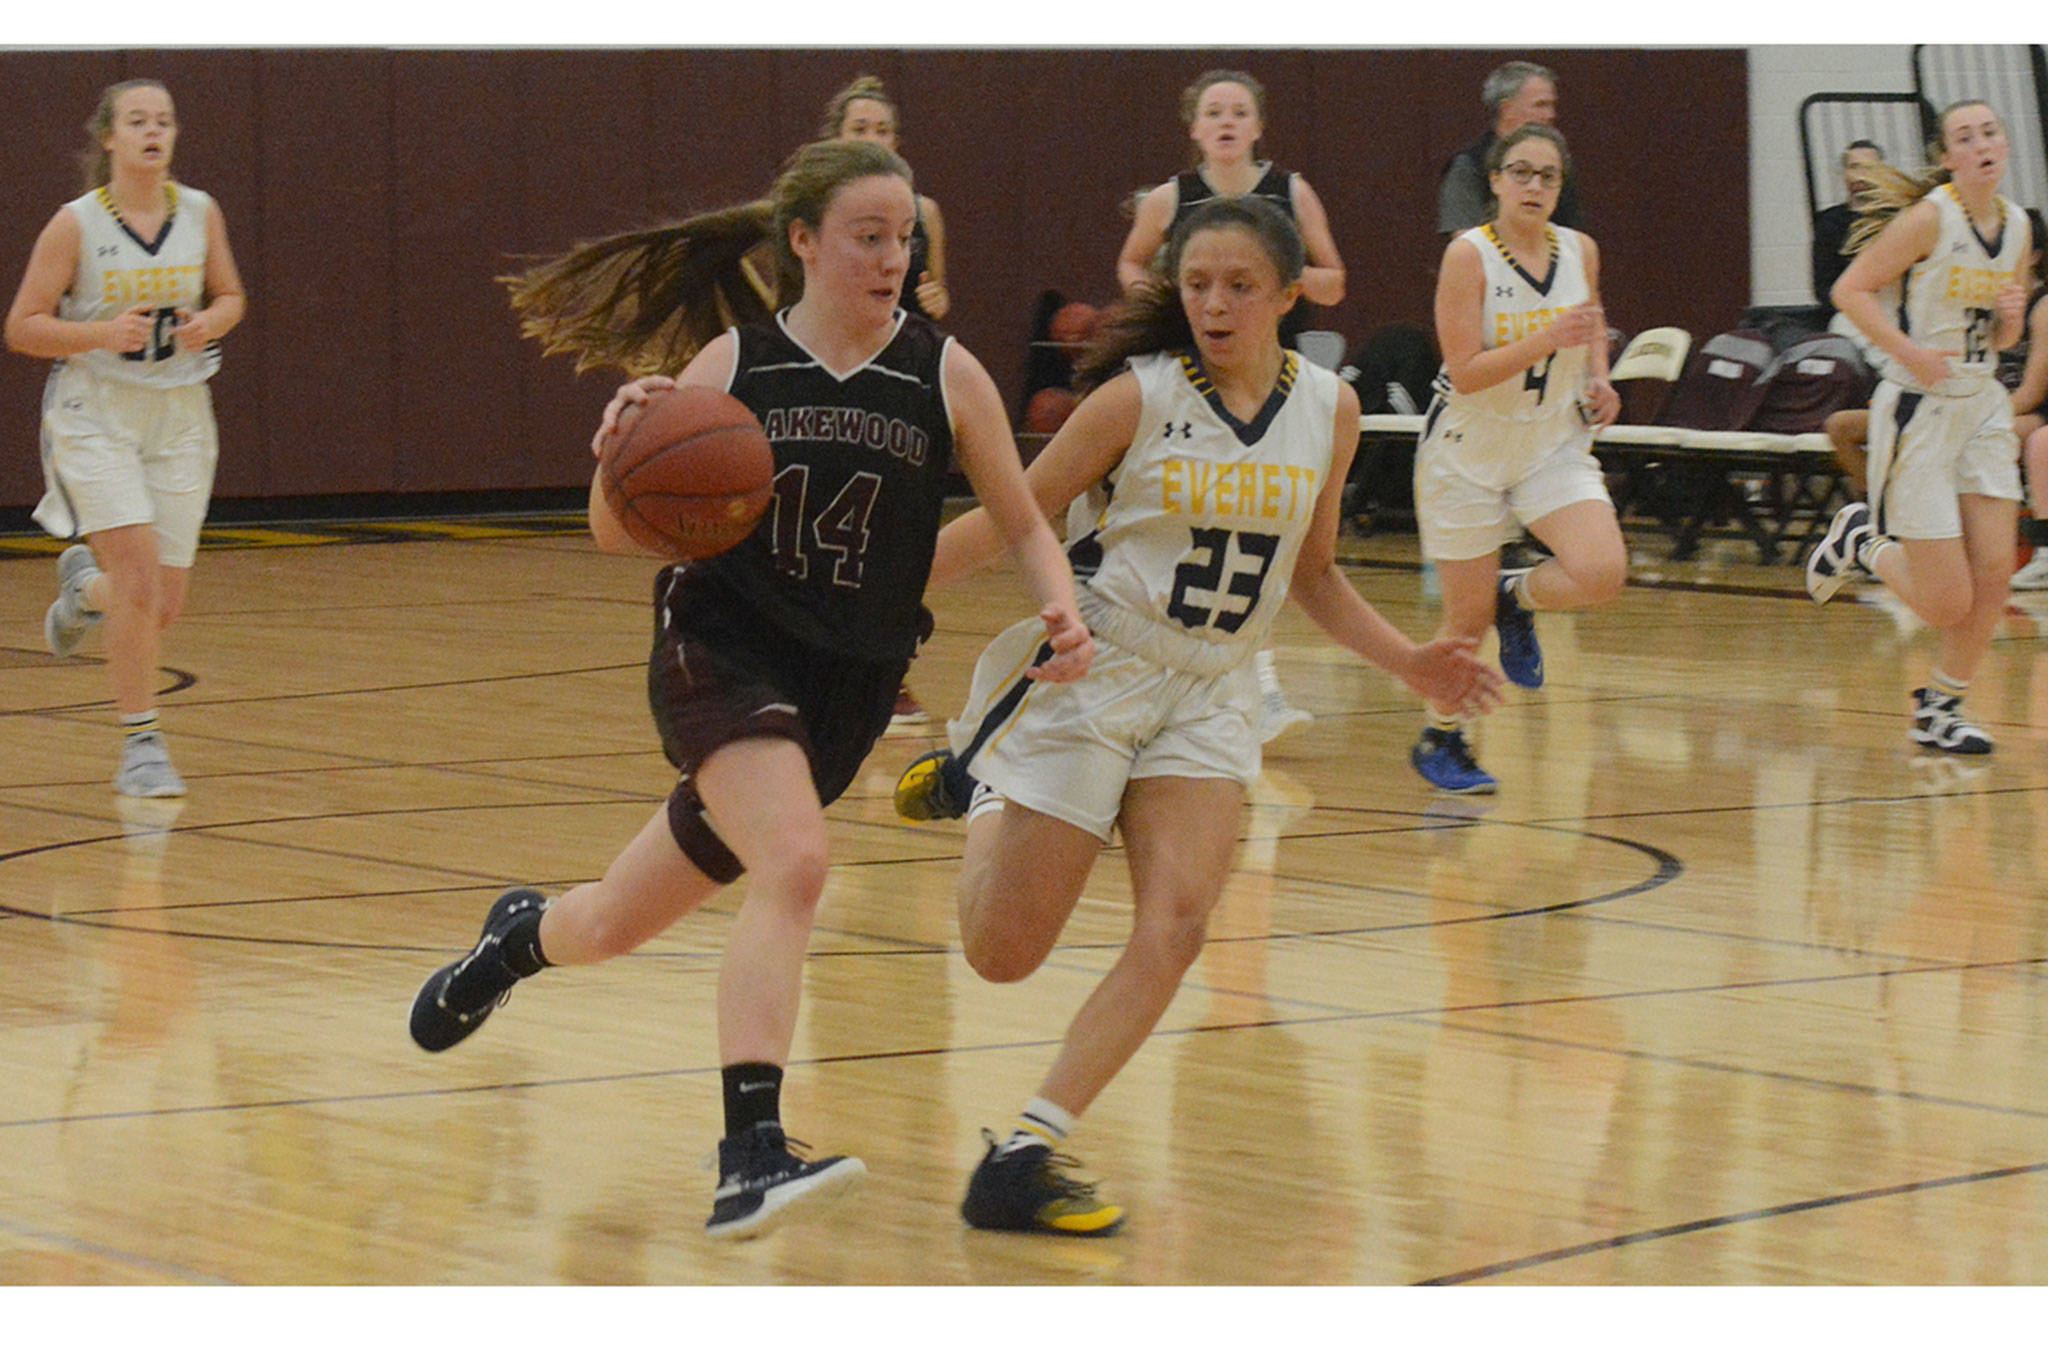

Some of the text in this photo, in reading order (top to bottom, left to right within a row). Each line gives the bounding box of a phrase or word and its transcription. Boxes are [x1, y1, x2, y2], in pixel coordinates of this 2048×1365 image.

[1523, 349, 1558, 405] 4
[764, 406, 930, 467] AKEWOOD
[771, 462, 883, 589] 14
[1166, 526, 1281, 635] 23
